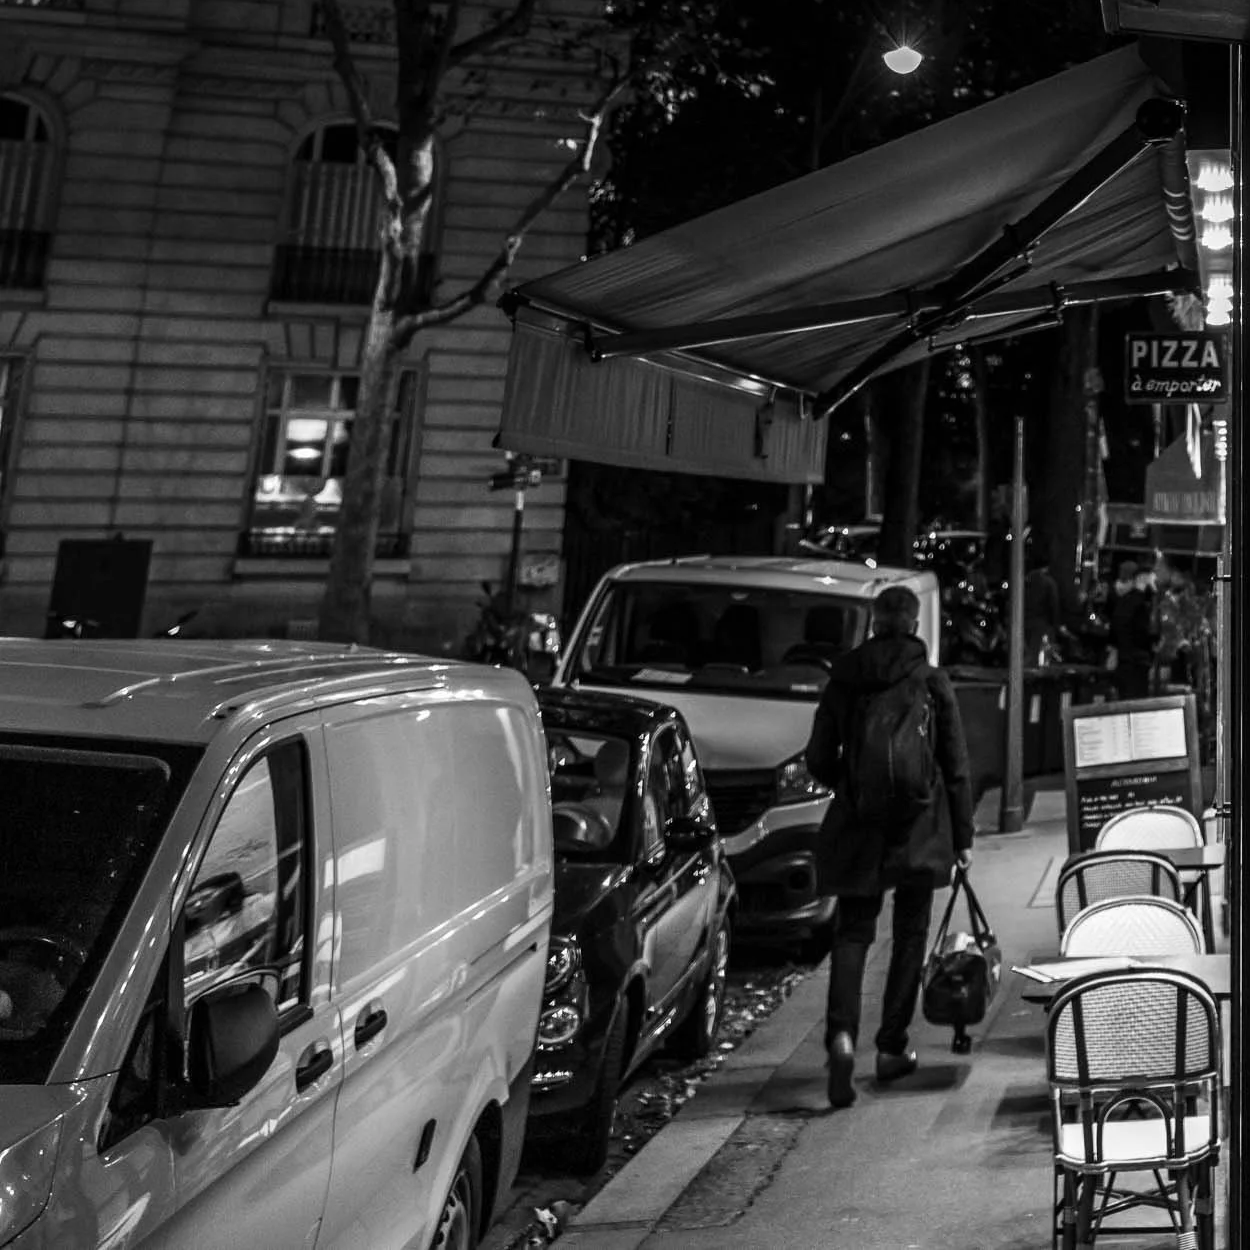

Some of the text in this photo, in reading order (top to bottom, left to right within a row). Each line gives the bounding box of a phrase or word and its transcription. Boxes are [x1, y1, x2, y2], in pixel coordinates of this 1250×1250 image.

[1132, 340, 1220, 368] PIZZA
[1131, 373, 1221, 398] à emporter
